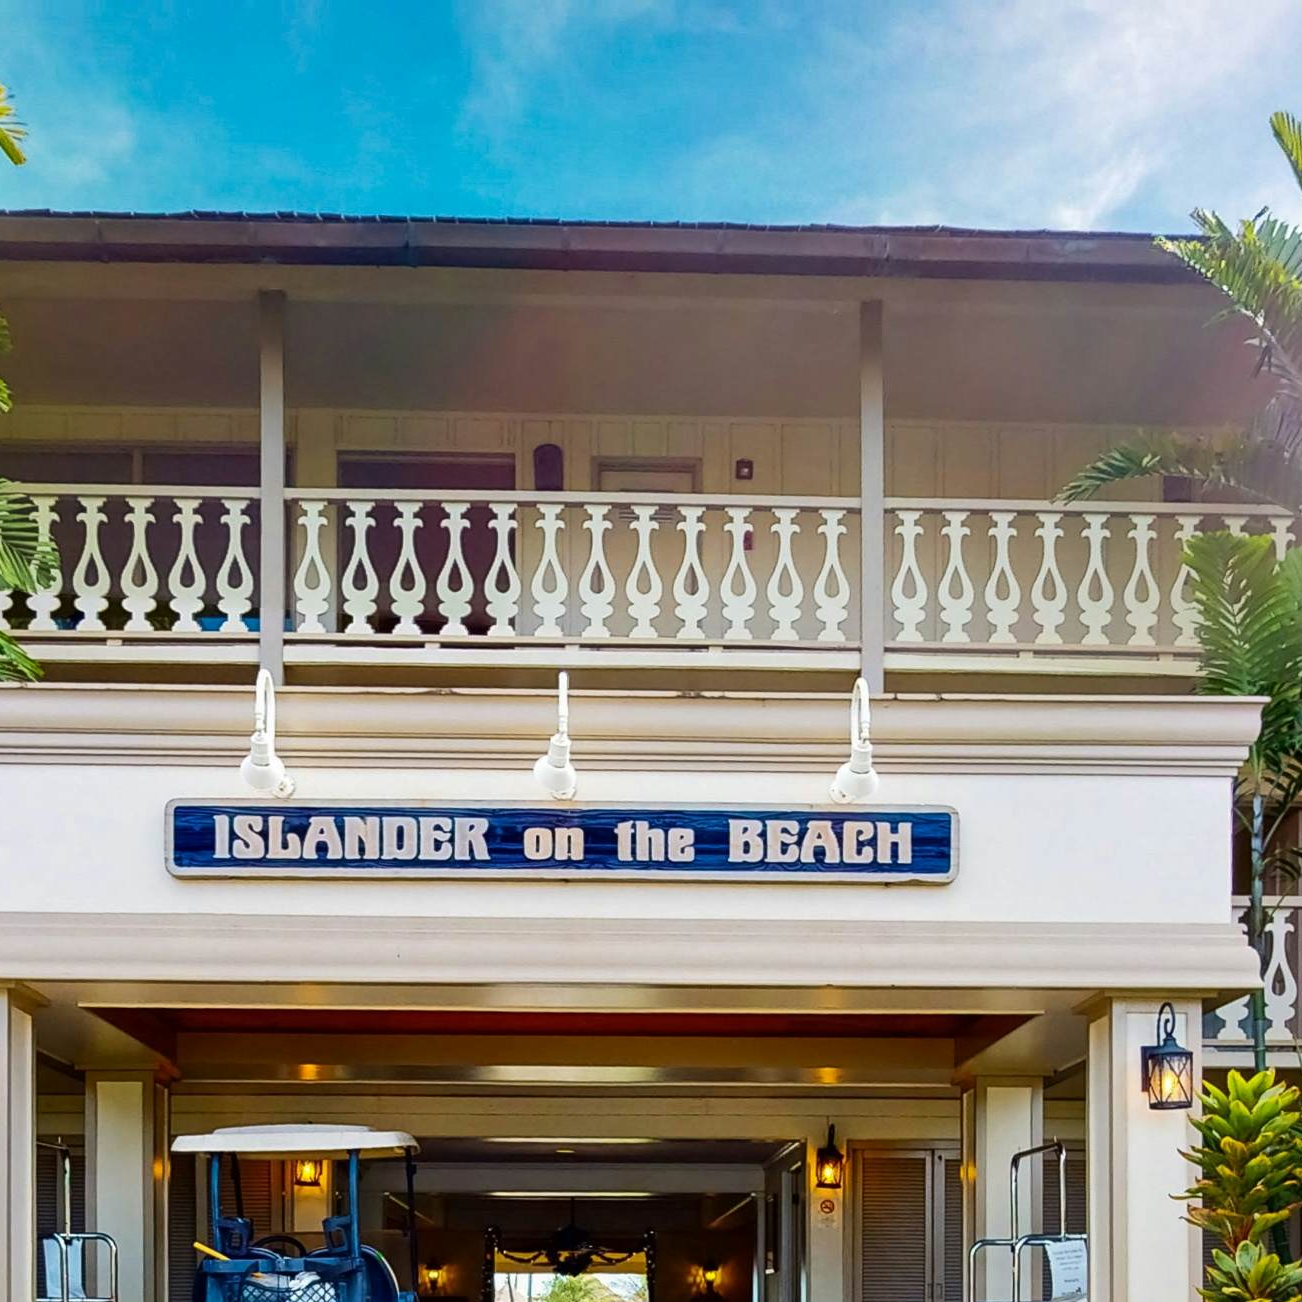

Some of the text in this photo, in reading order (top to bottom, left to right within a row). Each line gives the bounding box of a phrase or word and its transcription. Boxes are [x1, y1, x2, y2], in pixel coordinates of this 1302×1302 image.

[213, 814, 912, 864] ISLANDER on the BEACH
